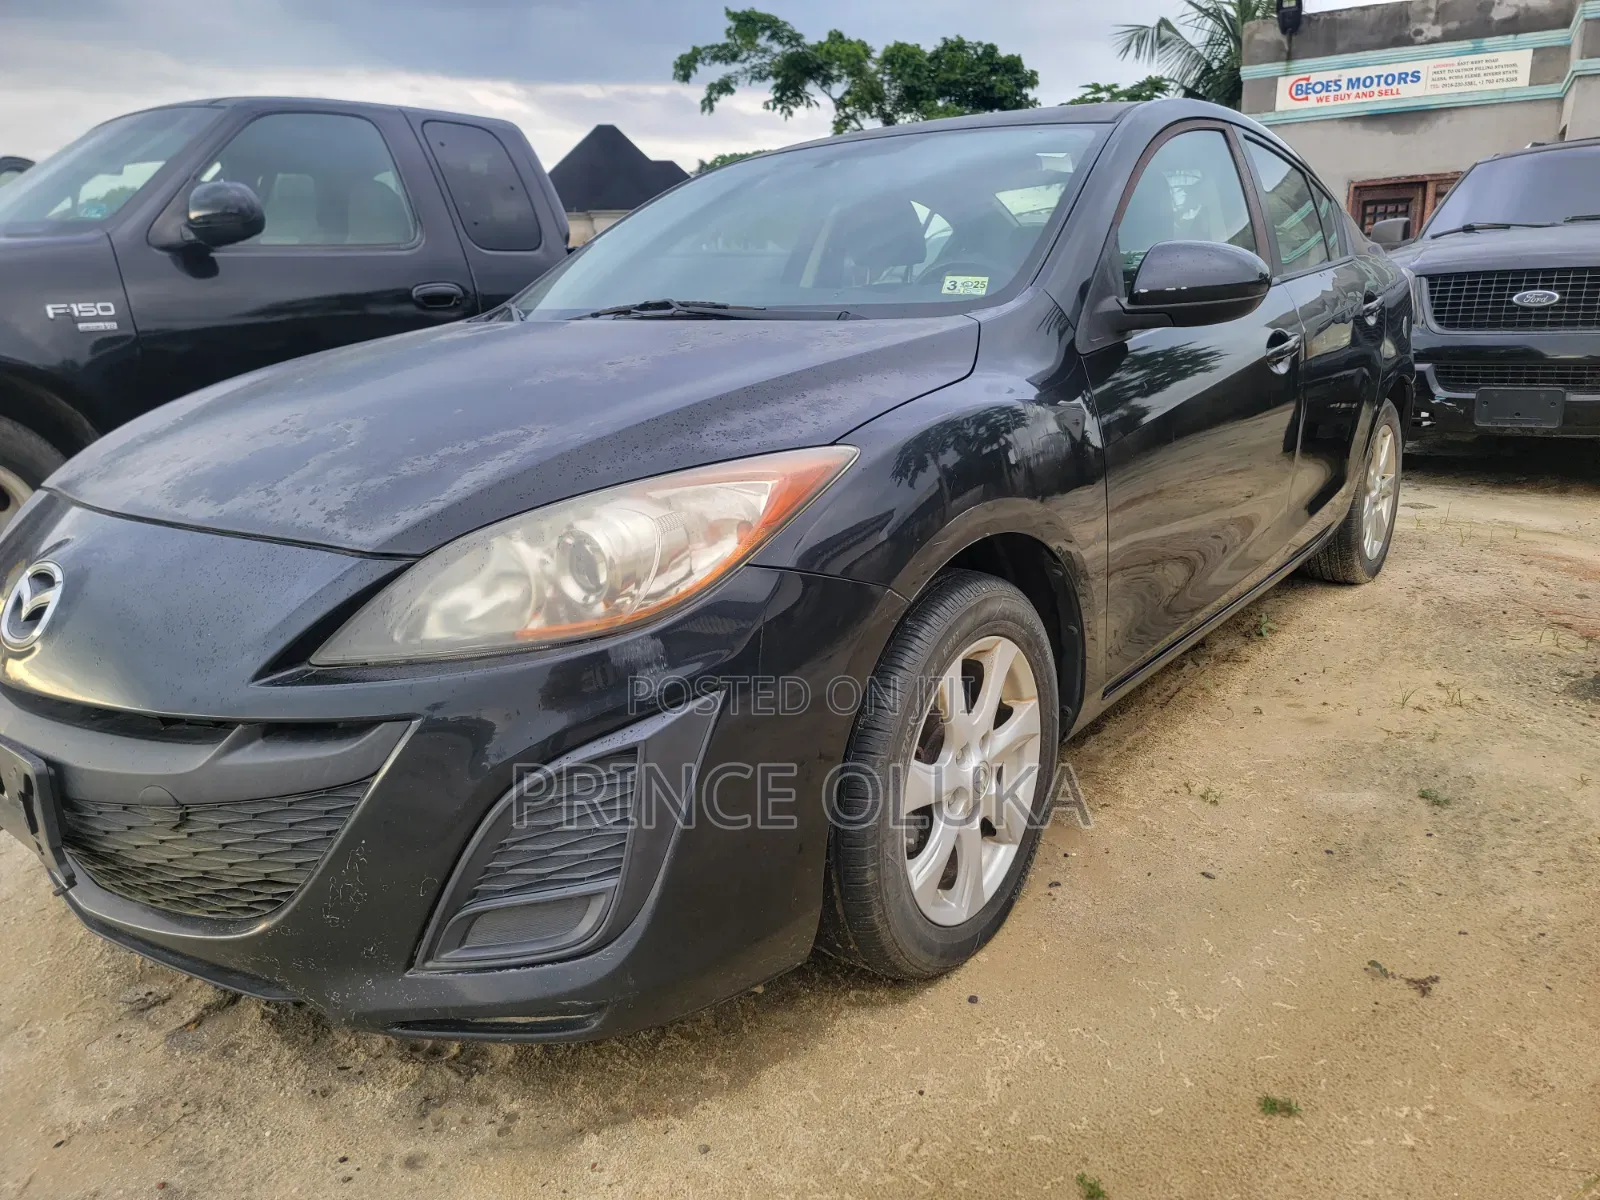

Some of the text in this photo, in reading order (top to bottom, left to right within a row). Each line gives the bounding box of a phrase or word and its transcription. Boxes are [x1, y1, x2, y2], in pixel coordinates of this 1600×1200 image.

[1346, 70, 1421, 90] MOTORS
[1316, 88, 1401, 103] WE BUY AND SELL
[946, 280, 986, 291] 3 25
[1523, 293, 1549, 303] Ford
